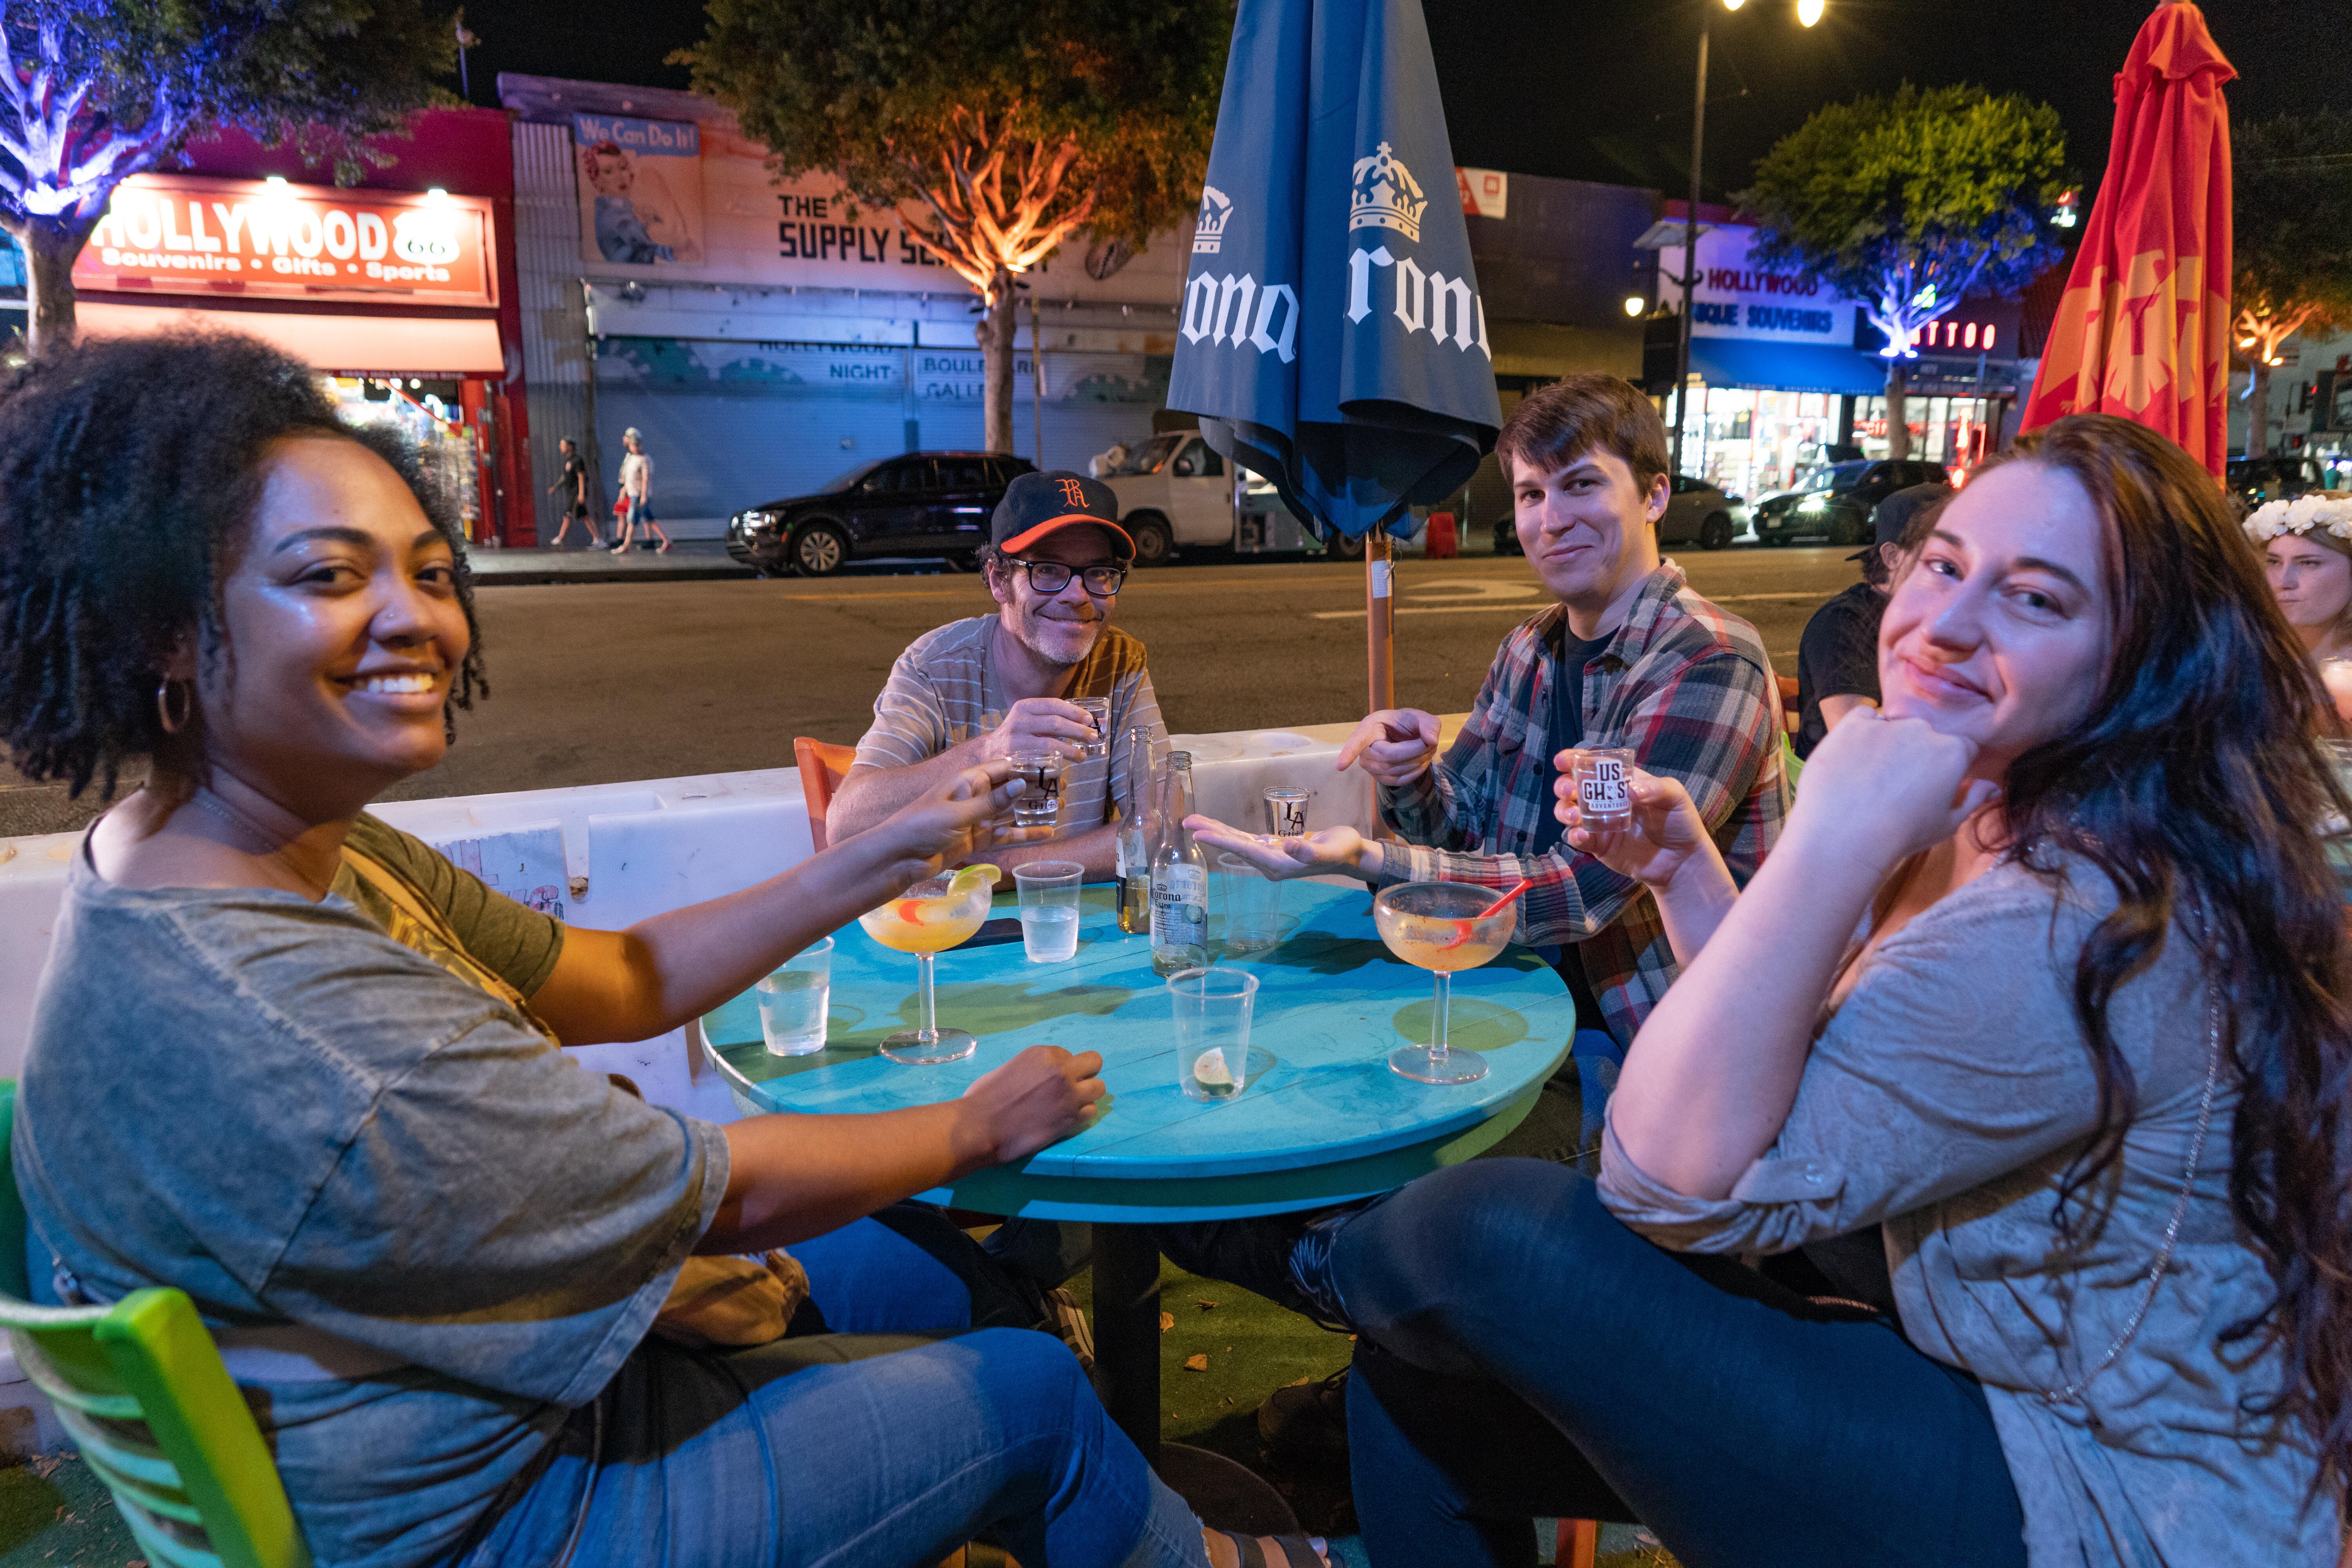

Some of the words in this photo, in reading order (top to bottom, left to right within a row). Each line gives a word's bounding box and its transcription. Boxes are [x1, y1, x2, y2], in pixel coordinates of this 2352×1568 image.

[579, 118, 609, 140] We
[612, 121, 646, 144] Can
[648, 123, 672, 147] Do
[676, 126, 694, 148] It!
[778, 196, 828, 219] THE
[89, 196, 388, 261] HOLLYWOOD
[780, 222, 889, 262] SUPPLY
[101, 247, 242, 272] Souvenirs
[272, 256, 336, 276] Gifts
[366, 261, 450, 282] Sports
[1708, 268, 1818, 296] HOLLYWOOD
[1181, 270, 1300, 364] ona
[1343, 245, 1491, 362] ron
[1908, 320, 1996, 350] TTOO
[1599, 763, 1620, 781] US
[1150, 888, 1181, 902] Corona
[1155, 899, 1171, 909] Extra
